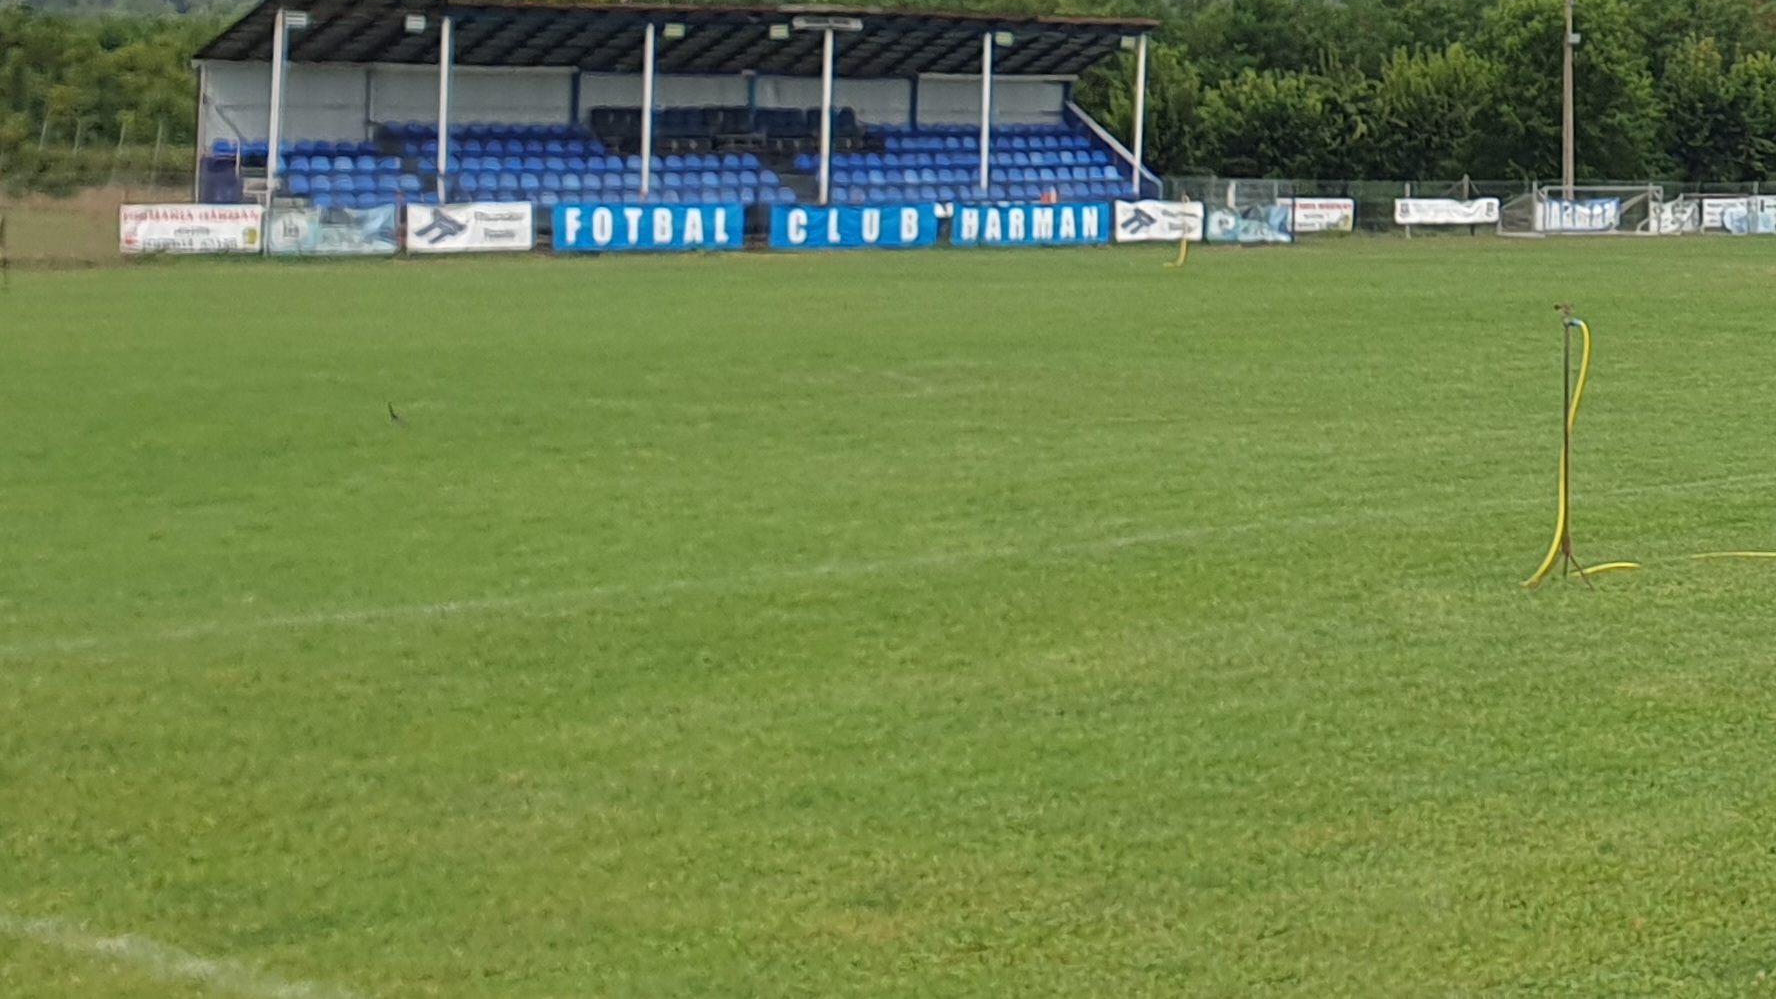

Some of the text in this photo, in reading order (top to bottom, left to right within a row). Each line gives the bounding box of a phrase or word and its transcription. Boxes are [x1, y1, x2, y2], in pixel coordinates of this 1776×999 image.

[565, 205, 1099, 245] FOTBAL CLUB HARMAN
